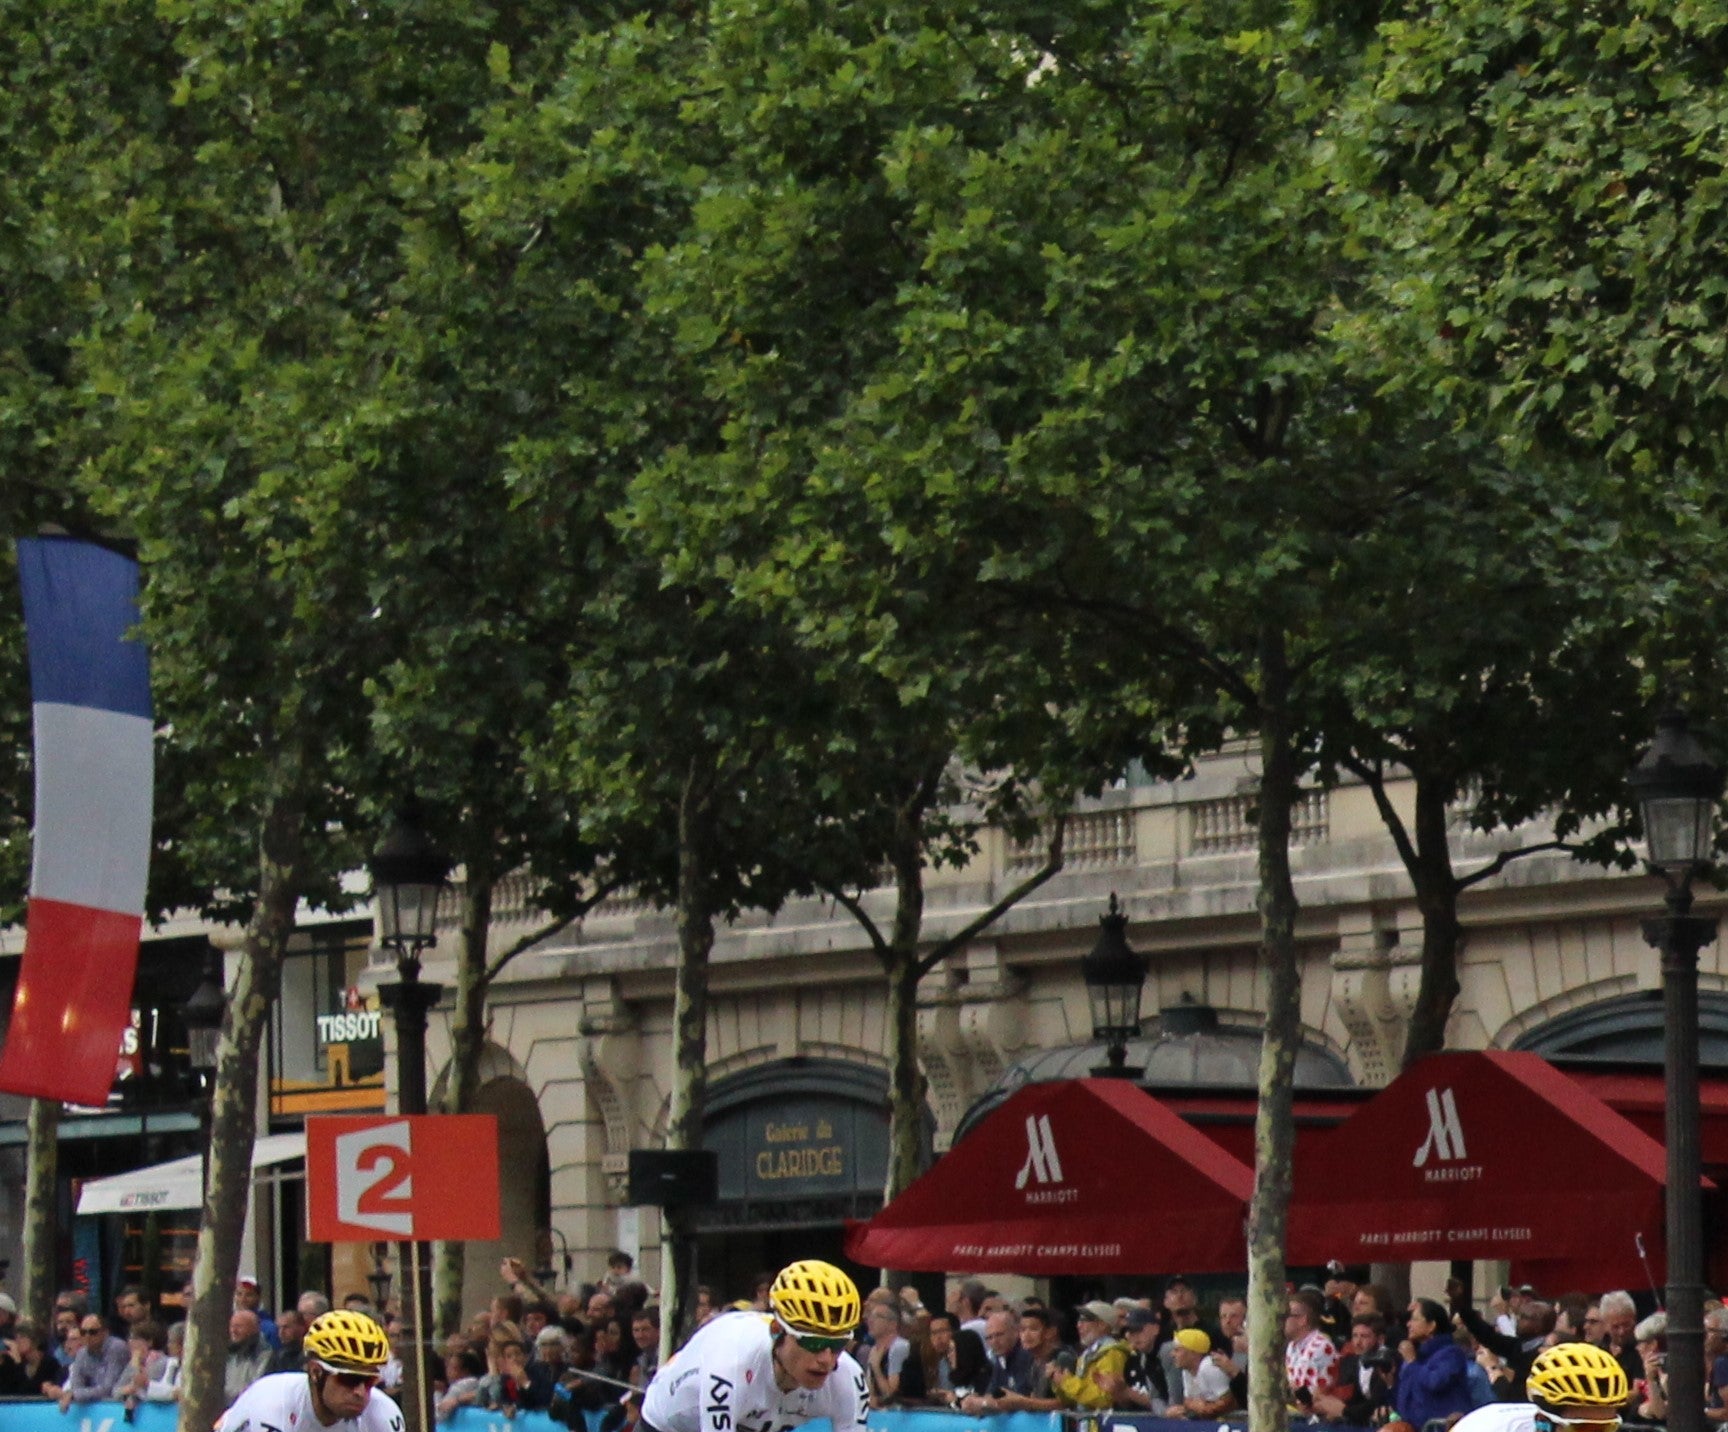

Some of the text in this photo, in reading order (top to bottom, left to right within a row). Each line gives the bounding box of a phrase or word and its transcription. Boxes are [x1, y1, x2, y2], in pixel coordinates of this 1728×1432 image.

[317, 1010, 382, 1043] TISSOT
[756, 1146, 843, 1180] CLARIDGE
[356, 1143, 412, 1215] 2
[1425, 1166, 1484, 1182] MARRIOTT
[1025, 1189, 1079, 1204] MARRIOTT
[1359, 1232, 1390, 1246] PARIS
[1393, 1229, 1442, 1244] MARRIOTT
[952, 1244, 984, 1257] PARIS
[986, 1244, 1035, 1257] MARRIOTT
[1036, 1243, 1078, 1257] CHAMPS
